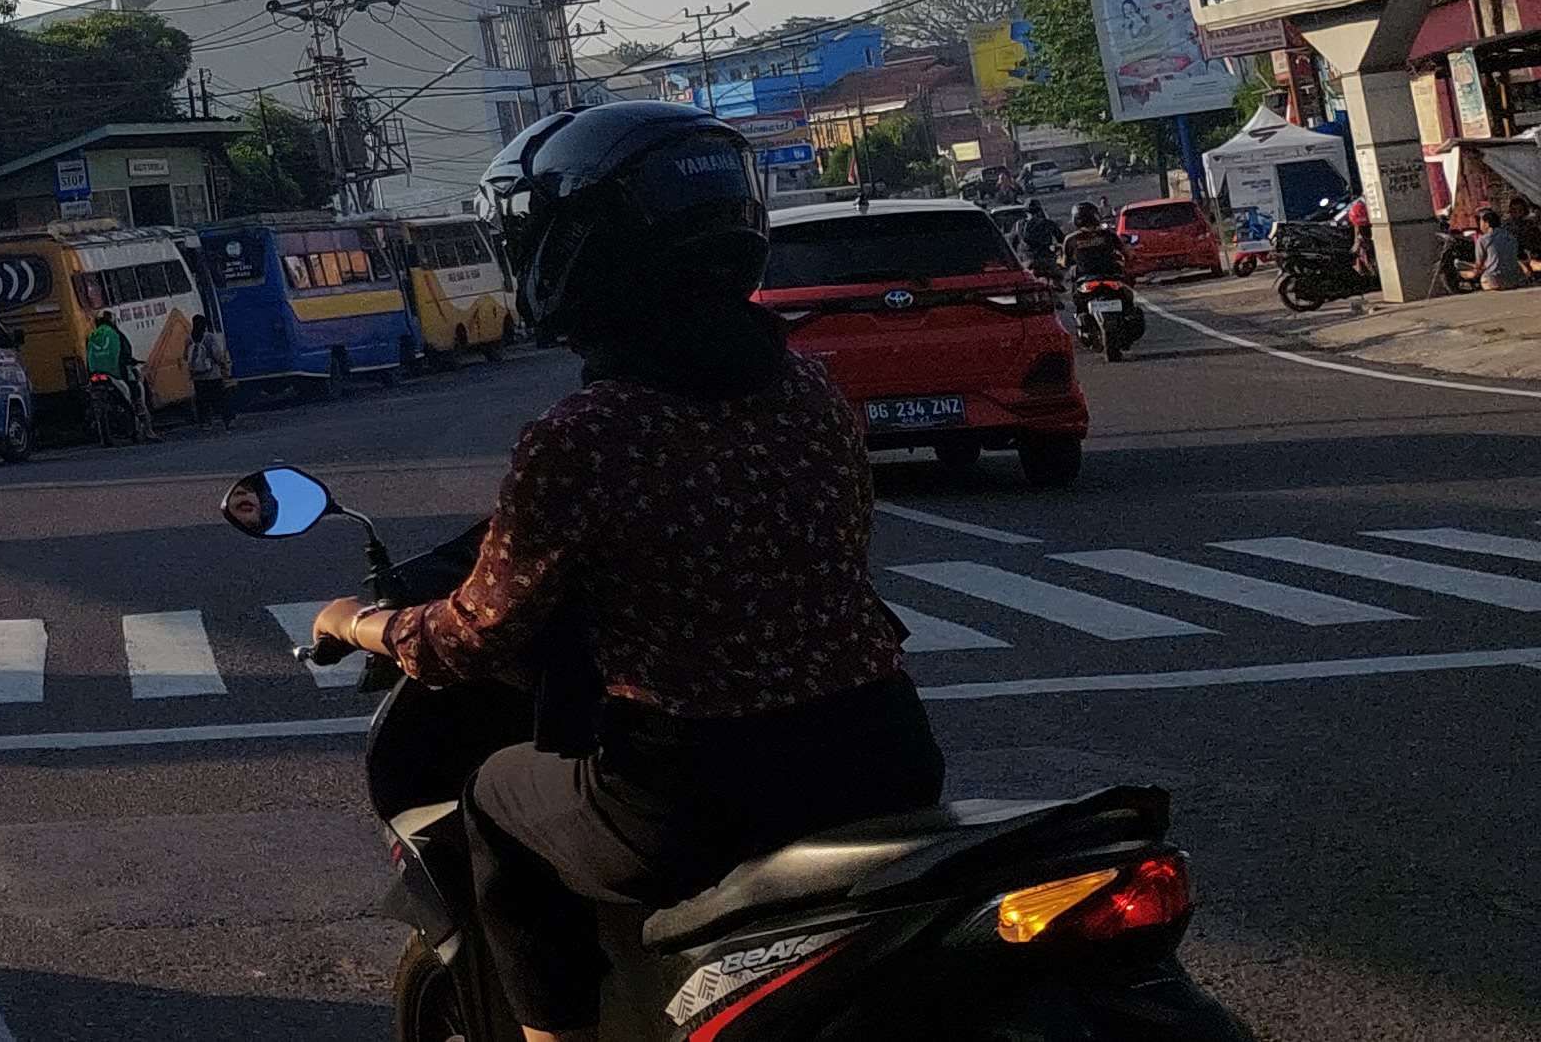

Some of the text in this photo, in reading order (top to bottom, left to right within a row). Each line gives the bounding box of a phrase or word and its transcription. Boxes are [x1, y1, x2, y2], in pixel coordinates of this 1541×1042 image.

[61, 174, 84, 187] STOP
[868, 398, 960, 419] BG 234 ZNZ
